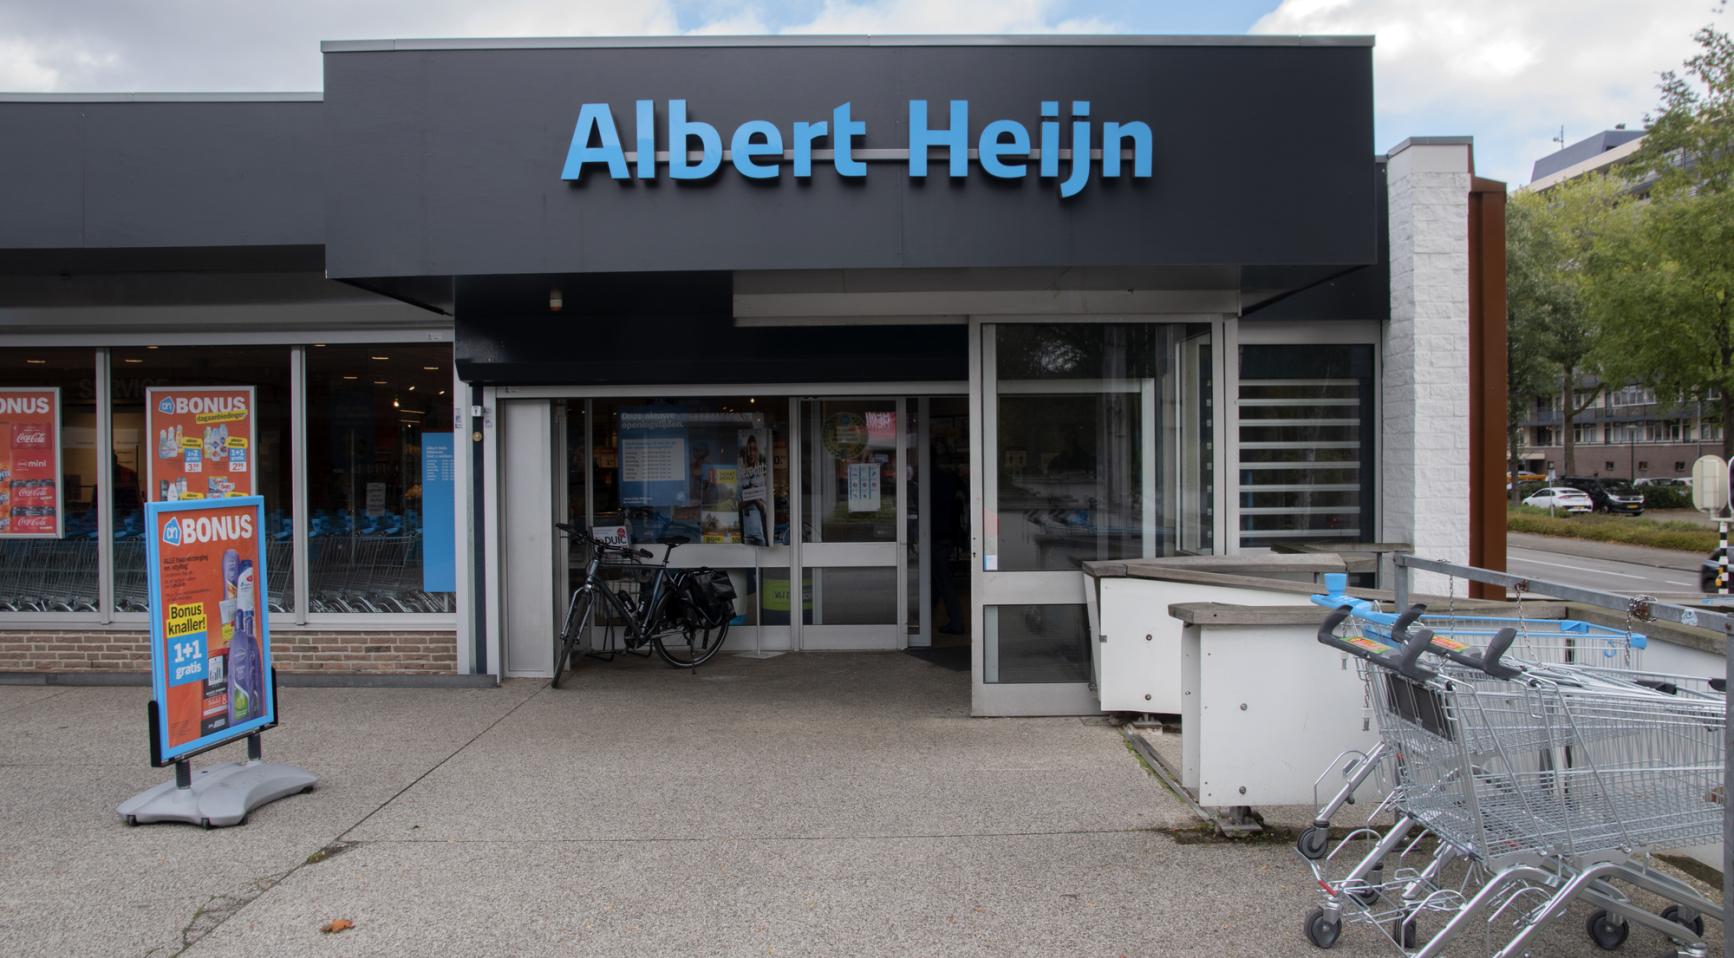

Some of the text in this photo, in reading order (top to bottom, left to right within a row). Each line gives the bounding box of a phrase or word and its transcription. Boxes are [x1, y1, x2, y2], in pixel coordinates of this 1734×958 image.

[561, 99, 1153, 199] Albert Heijn
[176, 397, 246, 414] BONUS
[28, 459, 47, 468] mini
[181, 514, 253, 544] BONUS
[170, 604, 202, 619] Bonus
[168, 617, 206, 636] knaller!
[174, 639, 202, 663] 1+1
[175, 661, 202, 680] gratis
